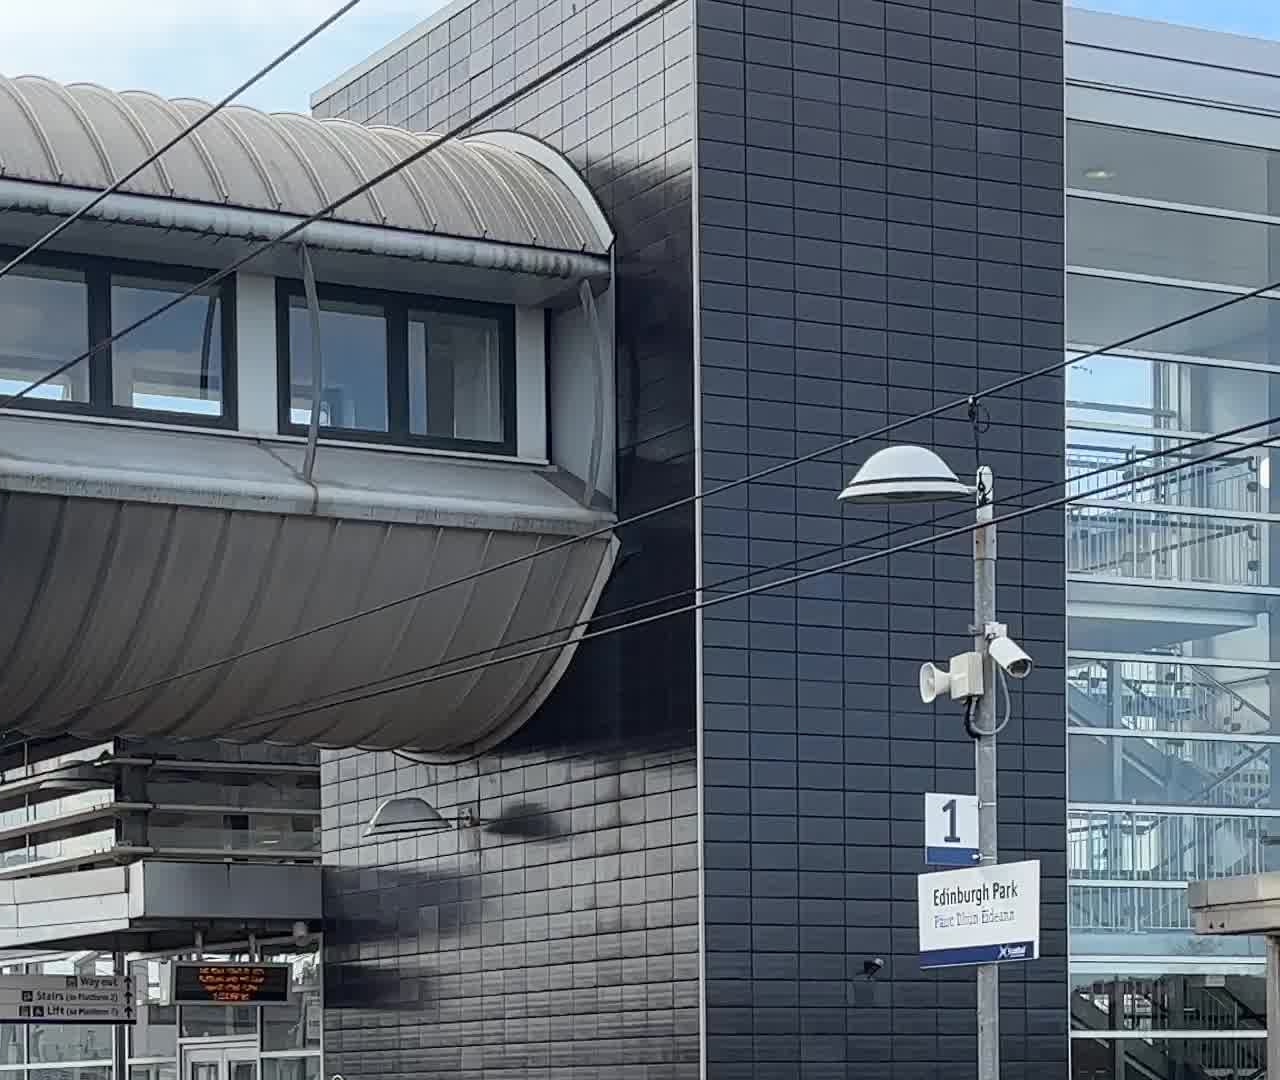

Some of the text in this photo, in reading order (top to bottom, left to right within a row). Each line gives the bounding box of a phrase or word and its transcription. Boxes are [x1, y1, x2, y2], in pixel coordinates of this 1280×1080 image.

[942, 799, 961, 843] 1
[933, 880, 1018, 906] Edinburgh Park
[80, 977, 99, 988] Way
[36, 991, 64, 1001] Stairs
[47, 1005, 65, 1016] Lift
